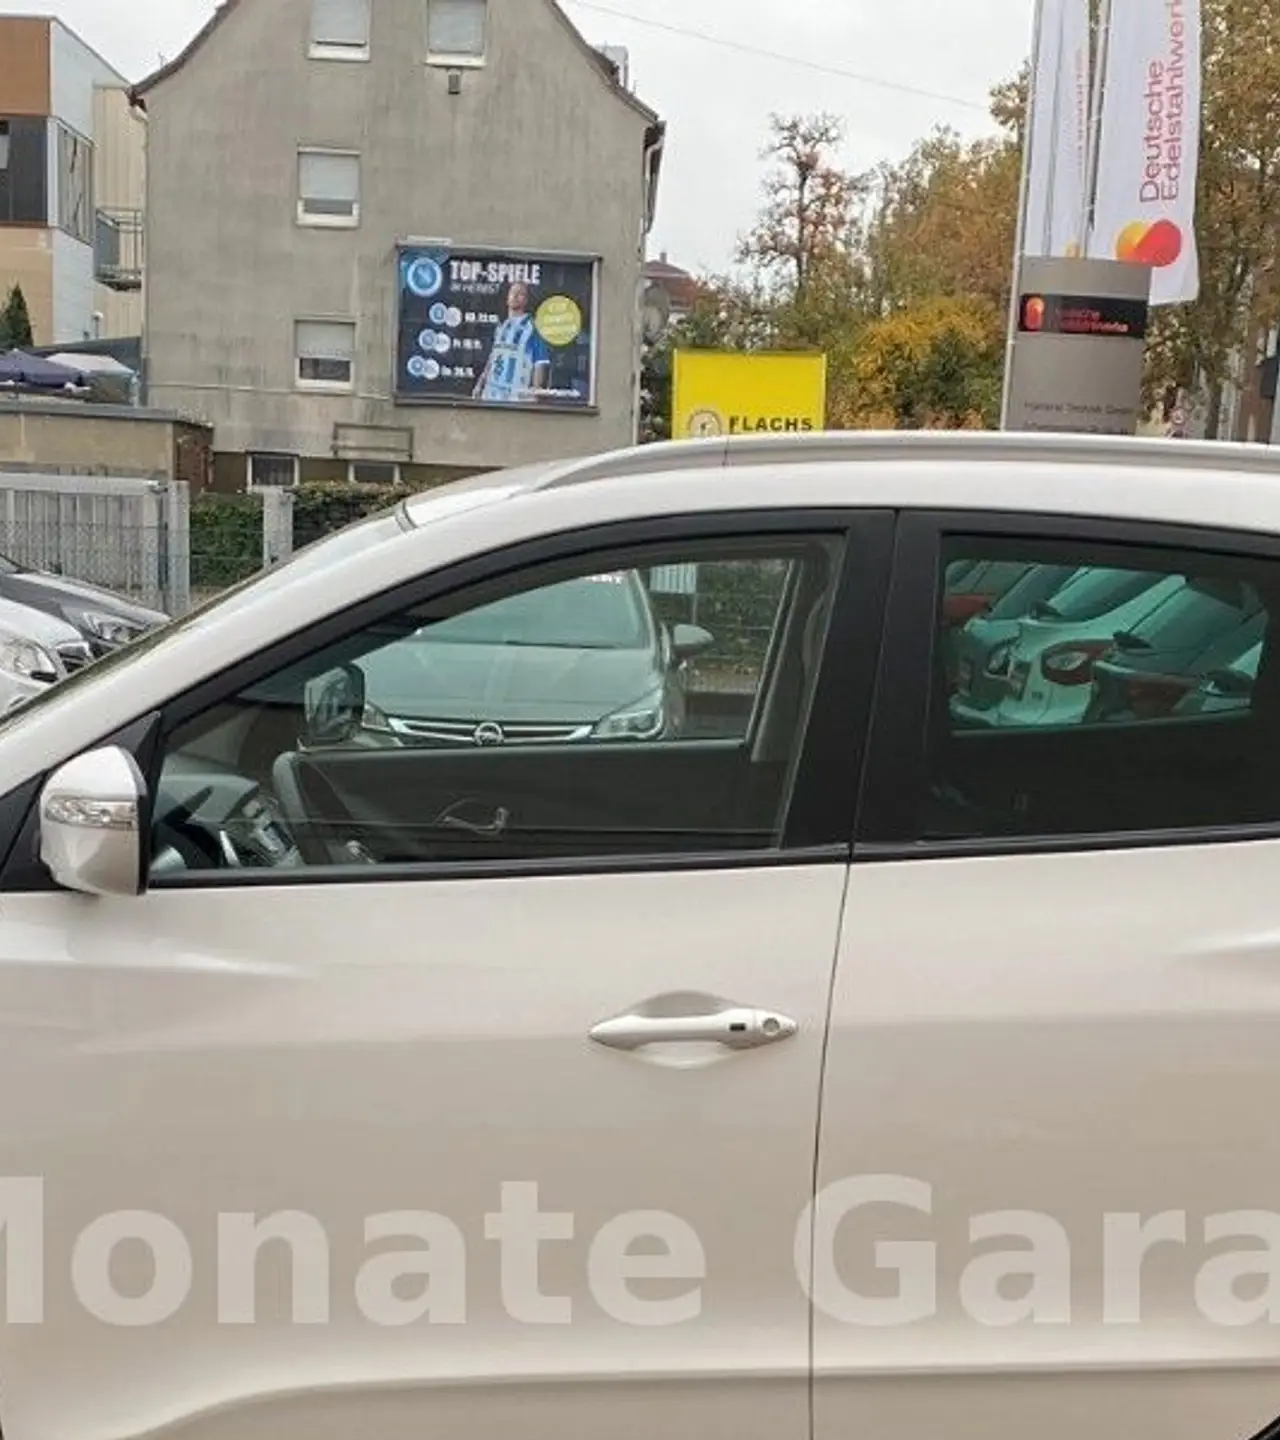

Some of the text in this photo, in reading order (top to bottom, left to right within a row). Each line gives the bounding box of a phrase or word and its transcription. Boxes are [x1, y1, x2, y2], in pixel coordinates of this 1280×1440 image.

[1139, 59, 1163, 202] Deutsche
[450, 260, 540, 285] TOP-SPIELE
[729, 415, 813, 434] FLACHS
